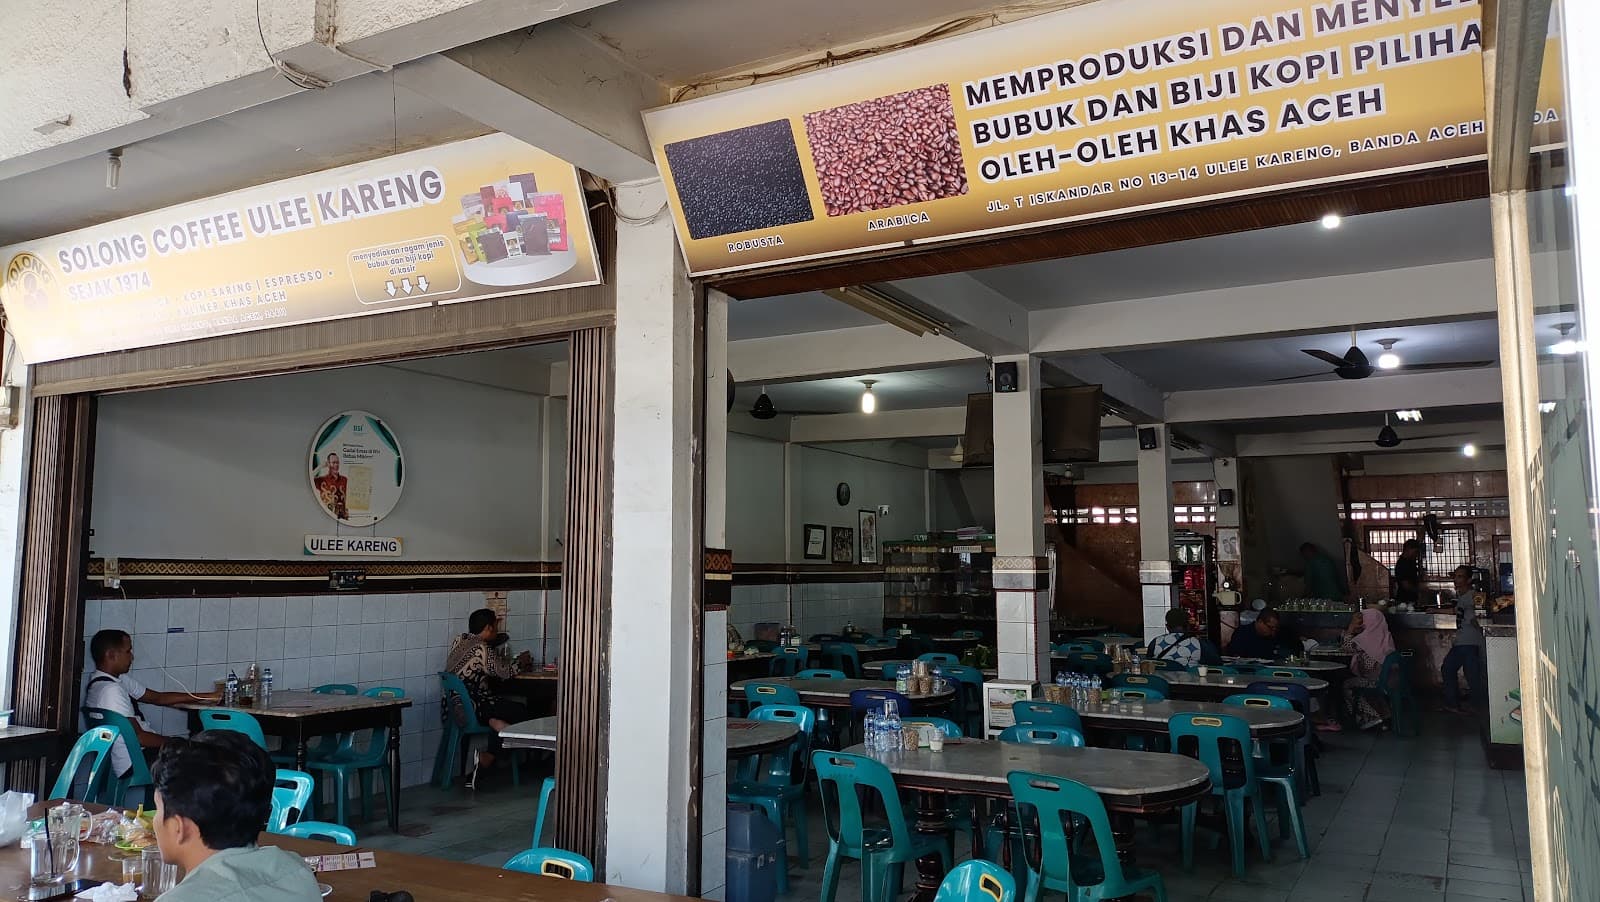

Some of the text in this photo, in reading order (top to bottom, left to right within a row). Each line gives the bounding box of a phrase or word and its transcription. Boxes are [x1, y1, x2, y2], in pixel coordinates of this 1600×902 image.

[966, 0, 1471, 106] MEMPRODUKSI DAN MENY
[973, 104, 1078, 144] BUBUK
[1087, 87, 1158, 121] DAN
[1171, 71, 1237, 105] BIJI
[1250, 50, 1338, 90] KOPI
[981, 88, 1382, 180] OLEH-OLEH KHAS ACEH
[987, 201, 1010, 212] JL.
[1016, 197, 1024, 207] T
[1030, 182, 1112, 204] ISKANDAR
[1120, 176, 1143, 189] NO
[1150, 168, 1199, 185] 13-14
[1207, 160, 1248, 176] ULEE
[1256, 146, 1341, 168] KARENG,
[1350, 132, 1419, 152] BANDA
[1429, 121, 1483, 140] ACEH
[58, 170, 442, 273] SOLONG COFFEE ULEE KARENG
[868, 212, 929, 231] ARABICA
[353, 240, 444, 261] menyediakan ragam jenis
[728, 236, 784, 252] ROBUSTA
[10, 255, 51, 288] SOLONG
[368, 251, 434, 268] bubuk dan biji kopi
[390, 265, 416, 275] di kasir
[68, 271, 152, 301] SEJAK 1974
[213, 283, 252, 298] SARING
[264, 270, 323, 289] ESPRESSO
[224, 296, 252, 309] KHAS
[257, 290, 287, 305] ACEH
[310, 538, 397, 552] ULEE KARENG
